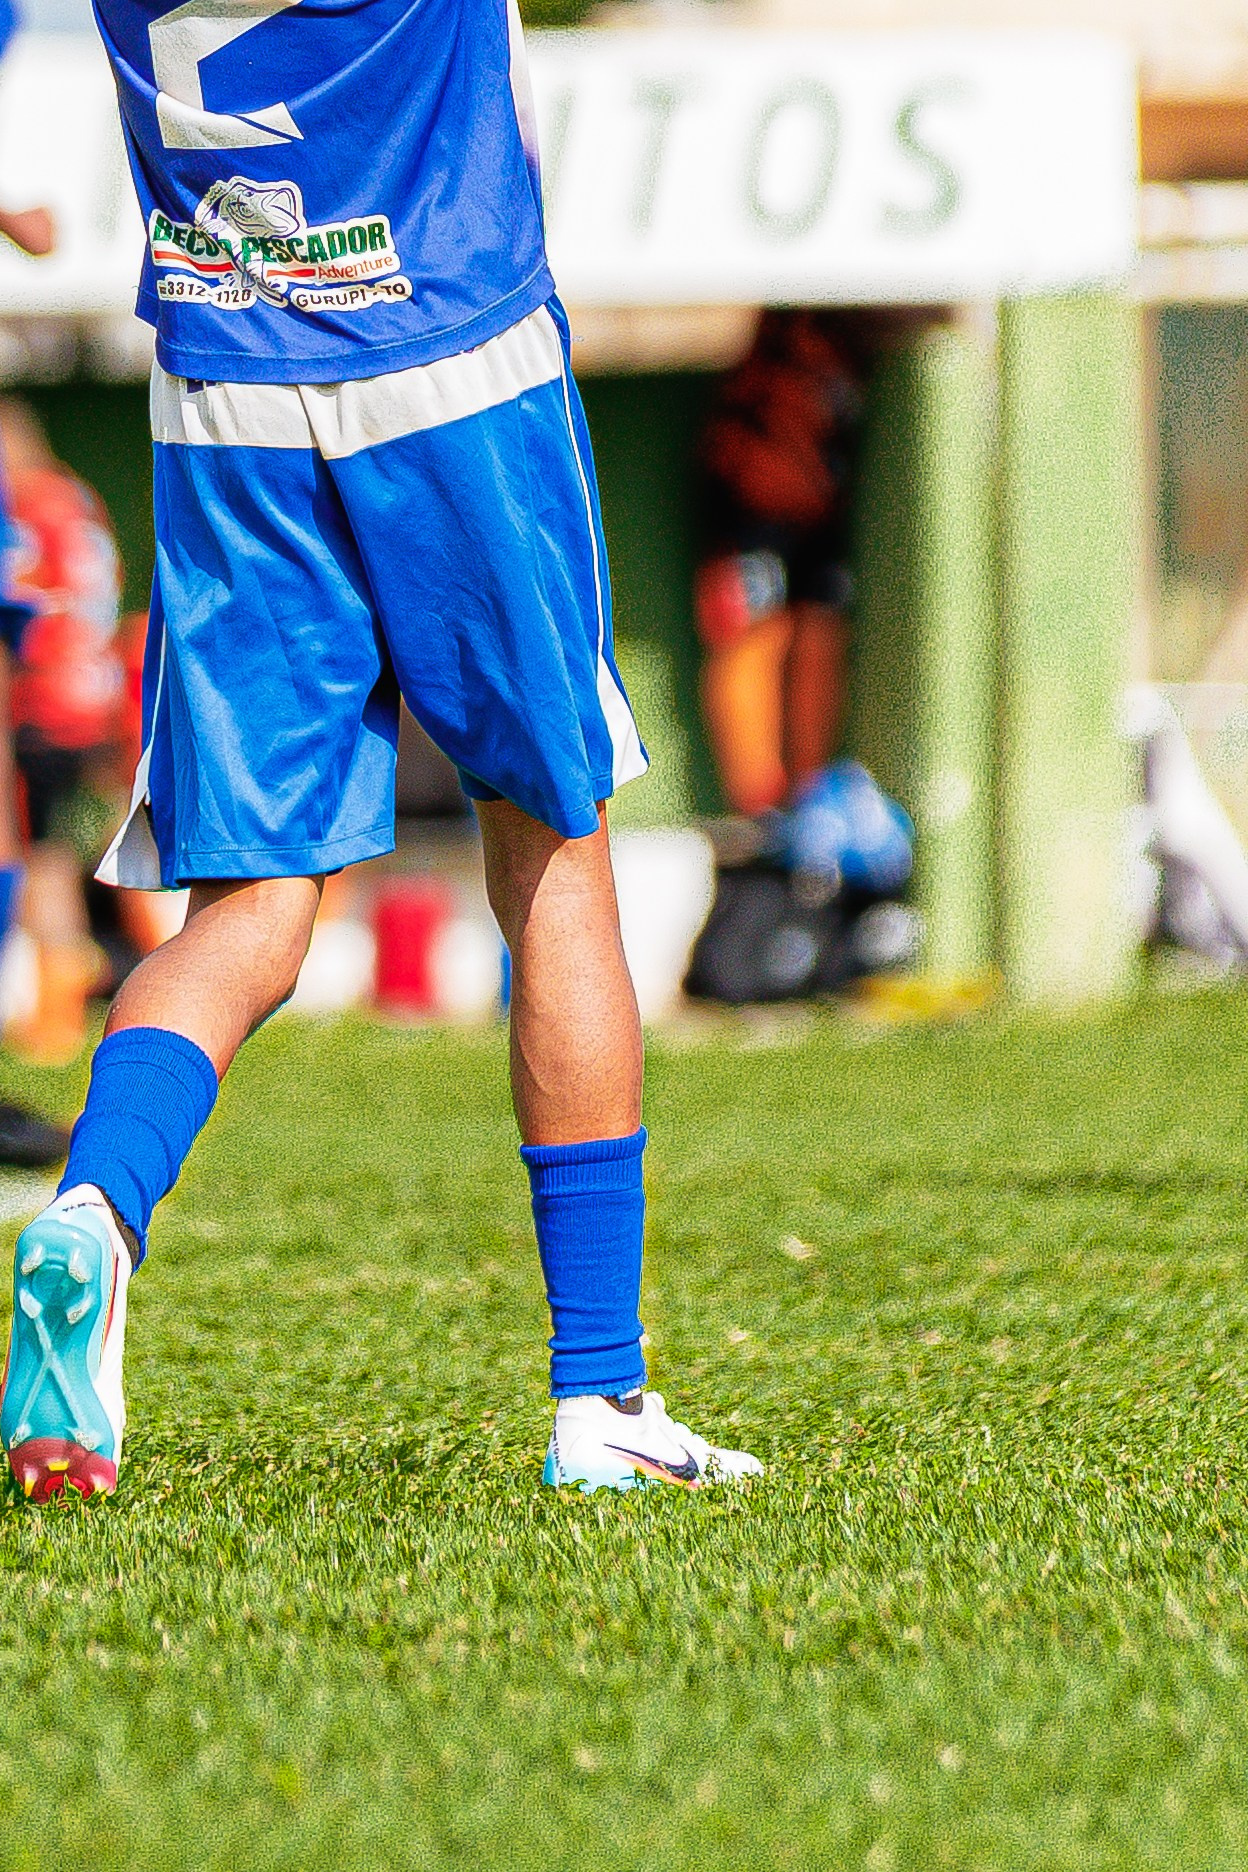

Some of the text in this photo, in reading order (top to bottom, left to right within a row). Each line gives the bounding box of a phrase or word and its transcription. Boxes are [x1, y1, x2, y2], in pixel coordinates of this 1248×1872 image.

[241, 222, 387, 265] PESCADOR
[318, 256, 393, 279] Adventure
[296, 288, 366, 308] GURUPI
[380, 283, 406, 297] TO
